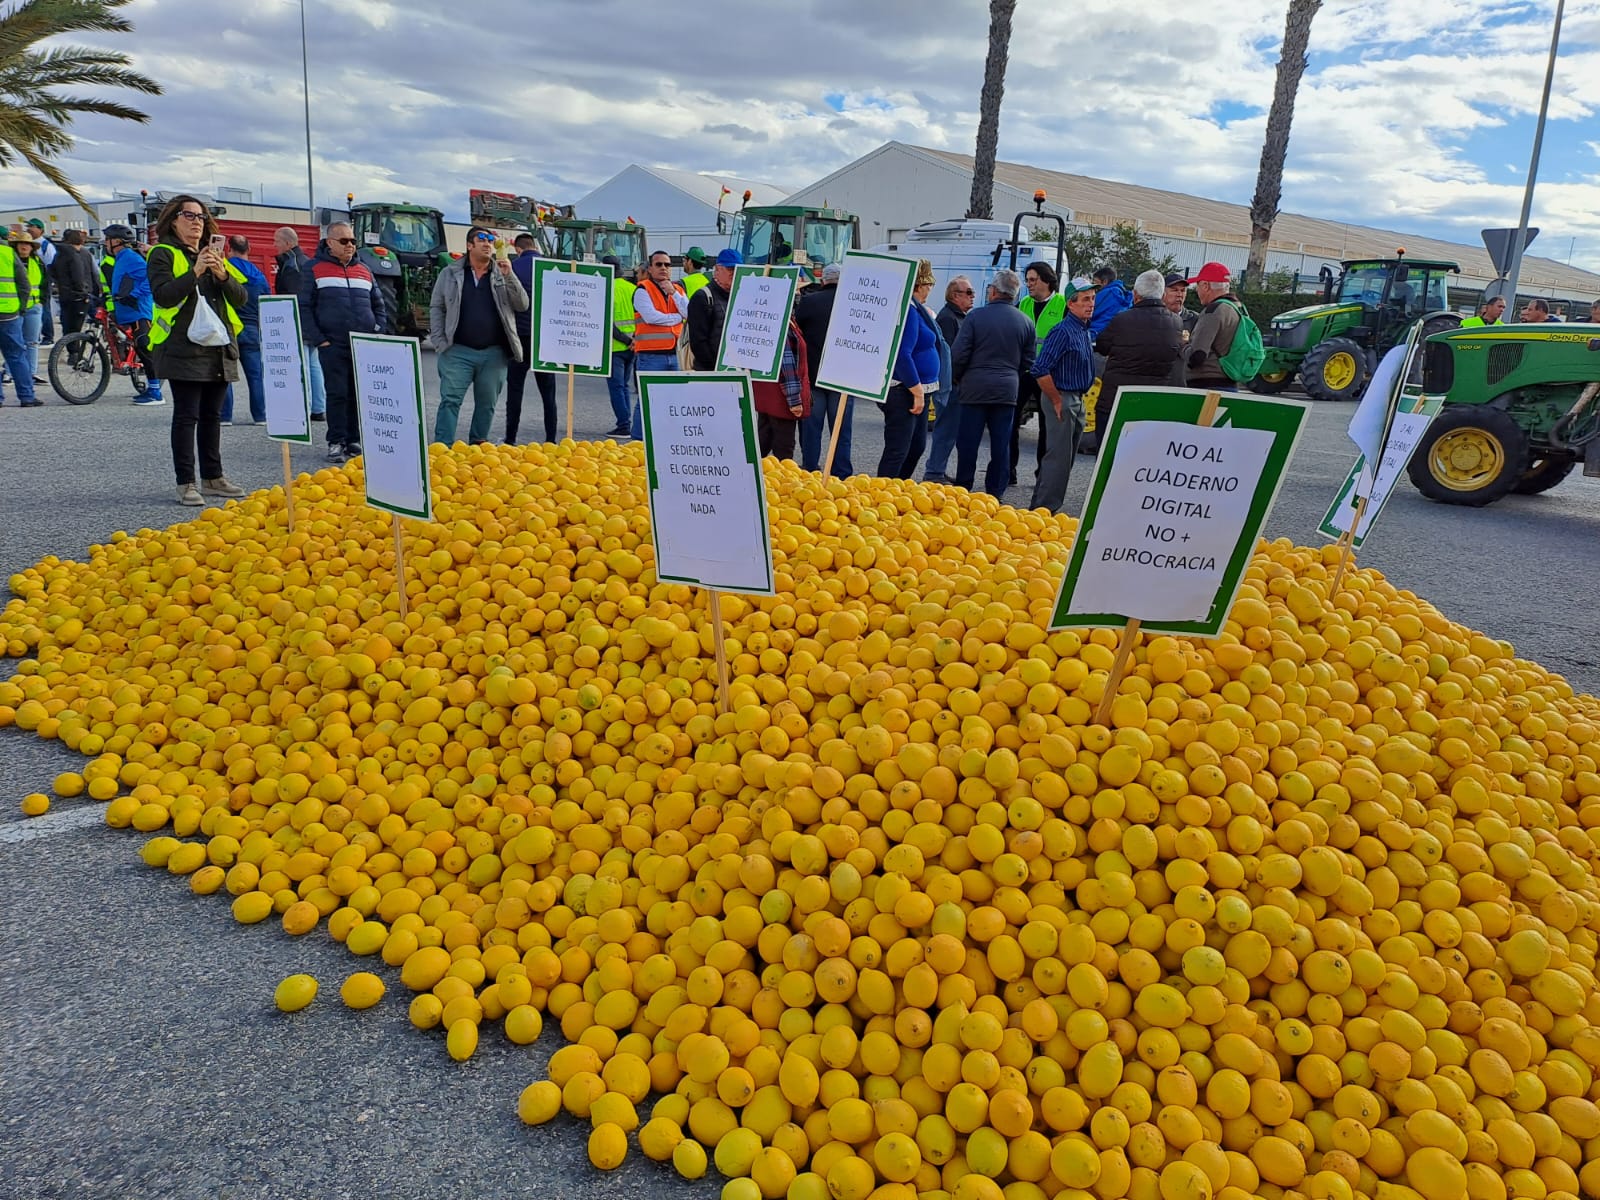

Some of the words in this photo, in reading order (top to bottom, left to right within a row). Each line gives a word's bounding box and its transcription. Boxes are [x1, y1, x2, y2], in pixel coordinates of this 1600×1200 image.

[569, 280, 597, 289] LIMONES
[858, 277, 870, 286] NO
[870, 279, 880, 289] AL
[577, 290, 589, 298] LOS
[848, 292, 888, 307] CUADERNO
[759, 298, 768, 306] LA
[559, 309, 591, 318] MIENTRAS
[850, 308, 876, 321] DIGITAL
[549, 318, 600, 330] ENRIQUECEMOS
[850, 325, 860, 334] NO
[835, 337, 880, 354] BUROCRACIA
[372, 364, 394, 375] CAMPO
[373, 380, 388, 390] ESTÁ
[669, 405, 679, 416] EL
[681, 406, 715, 417] CAMPO
[382, 428, 398, 440] HACE
[683, 424, 704, 436] ESTÁ
[378, 444, 394, 454] NADA
[670, 445, 716, 458] SEDIENTO,
[717, 446, 724, 456] Y
[1166, 441, 1198, 460] NO
[1201, 447, 1224, 463] AL
[670, 464, 680, 474] EL
[682, 464, 730, 477] GOBIERNO
[1134, 467, 1239, 492] CUADERNO
[682, 483, 694, 494] NO
[697, 485, 721, 495] HACE
[690, 503, 716, 514] NADA
[1141, 495, 1212, 519] DIGITAL
[1145, 524, 1176, 542] NO
[1181, 532, 1191, 543] +
[1101, 548, 1215, 571] BUROCRACIA
